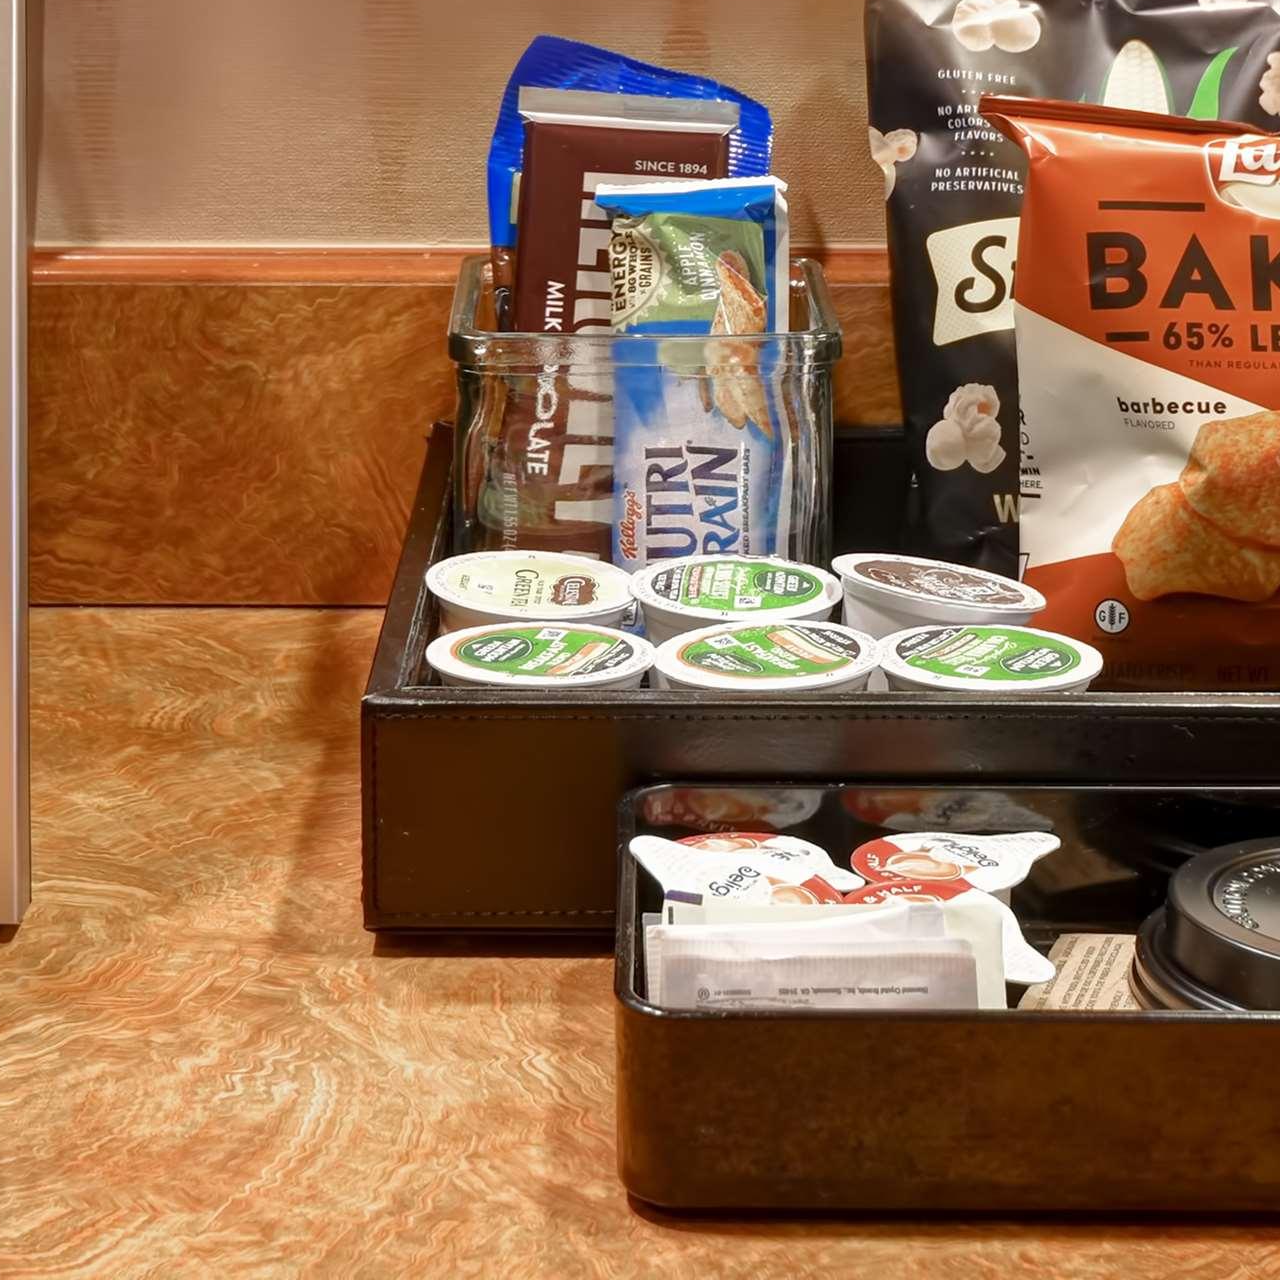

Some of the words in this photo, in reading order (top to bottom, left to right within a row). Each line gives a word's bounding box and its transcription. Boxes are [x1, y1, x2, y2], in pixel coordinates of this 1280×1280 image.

[937, 69, 983, 81] GLUTEN
[987, 73, 1017, 85] FREE
[937, 105, 952, 116] NO
[947, 116, 991, 129] COLORS
[954, 130, 1004, 142] FLAVORS
[634, 159, 675, 173] SINCE
[679, 162, 708, 175] 1894
[935, 167, 951, 178] NO
[955, 166, 1020, 180] ARTIFICIAL
[931, 180, 1024, 194] PRESERVATIVES
[625, 230, 639, 275] WHOLE
[678, 243, 698, 286] APPLE
[611, 228, 628, 312] ENERGY
[639, 246, 653, 289] GRAINS
[954, 235, 1017, 314] S
[544, 280, 566, 332] MILK
[1162, 322, 1234, 351] 65%
[1188, 359, 1222, 369] THAN
[1117, 396, 1227, 415] barbecue
[1123, 418, 1176, 430] FLAVORED
[645, 446, 697, 563] UTRI
[685, 445, 740, 556] RAIN
[993, 494, 1020, 524] W
[618, 489, 643, 561] Kellogg's
[876, 884, 923, 898] HALF
